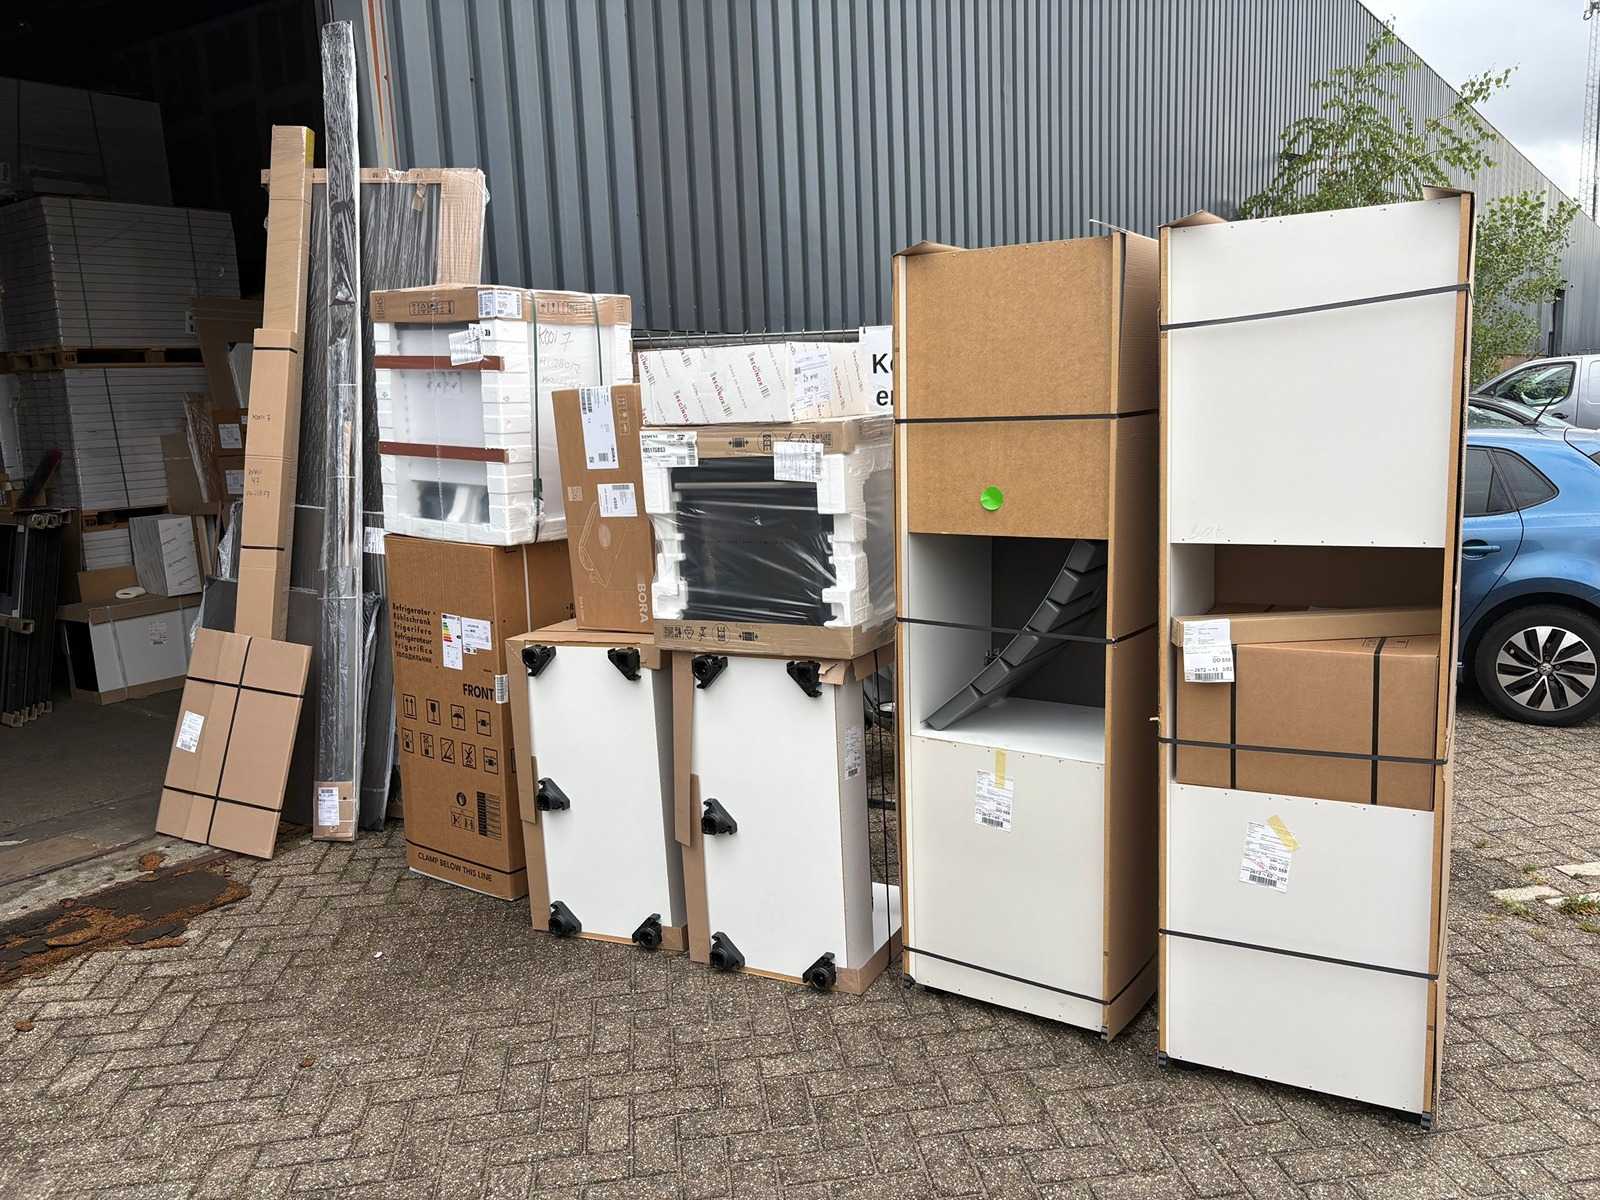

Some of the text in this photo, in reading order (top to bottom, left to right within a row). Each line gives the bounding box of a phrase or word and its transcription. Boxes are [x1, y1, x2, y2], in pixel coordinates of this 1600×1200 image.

[392, 602, 431, 617] Refrigerator
[637, 583, 649, 624] BORA
[463, 683, 495, 701] FRONT
[417, 852, 493, 882] CLAMP BELOW THIS LINE
